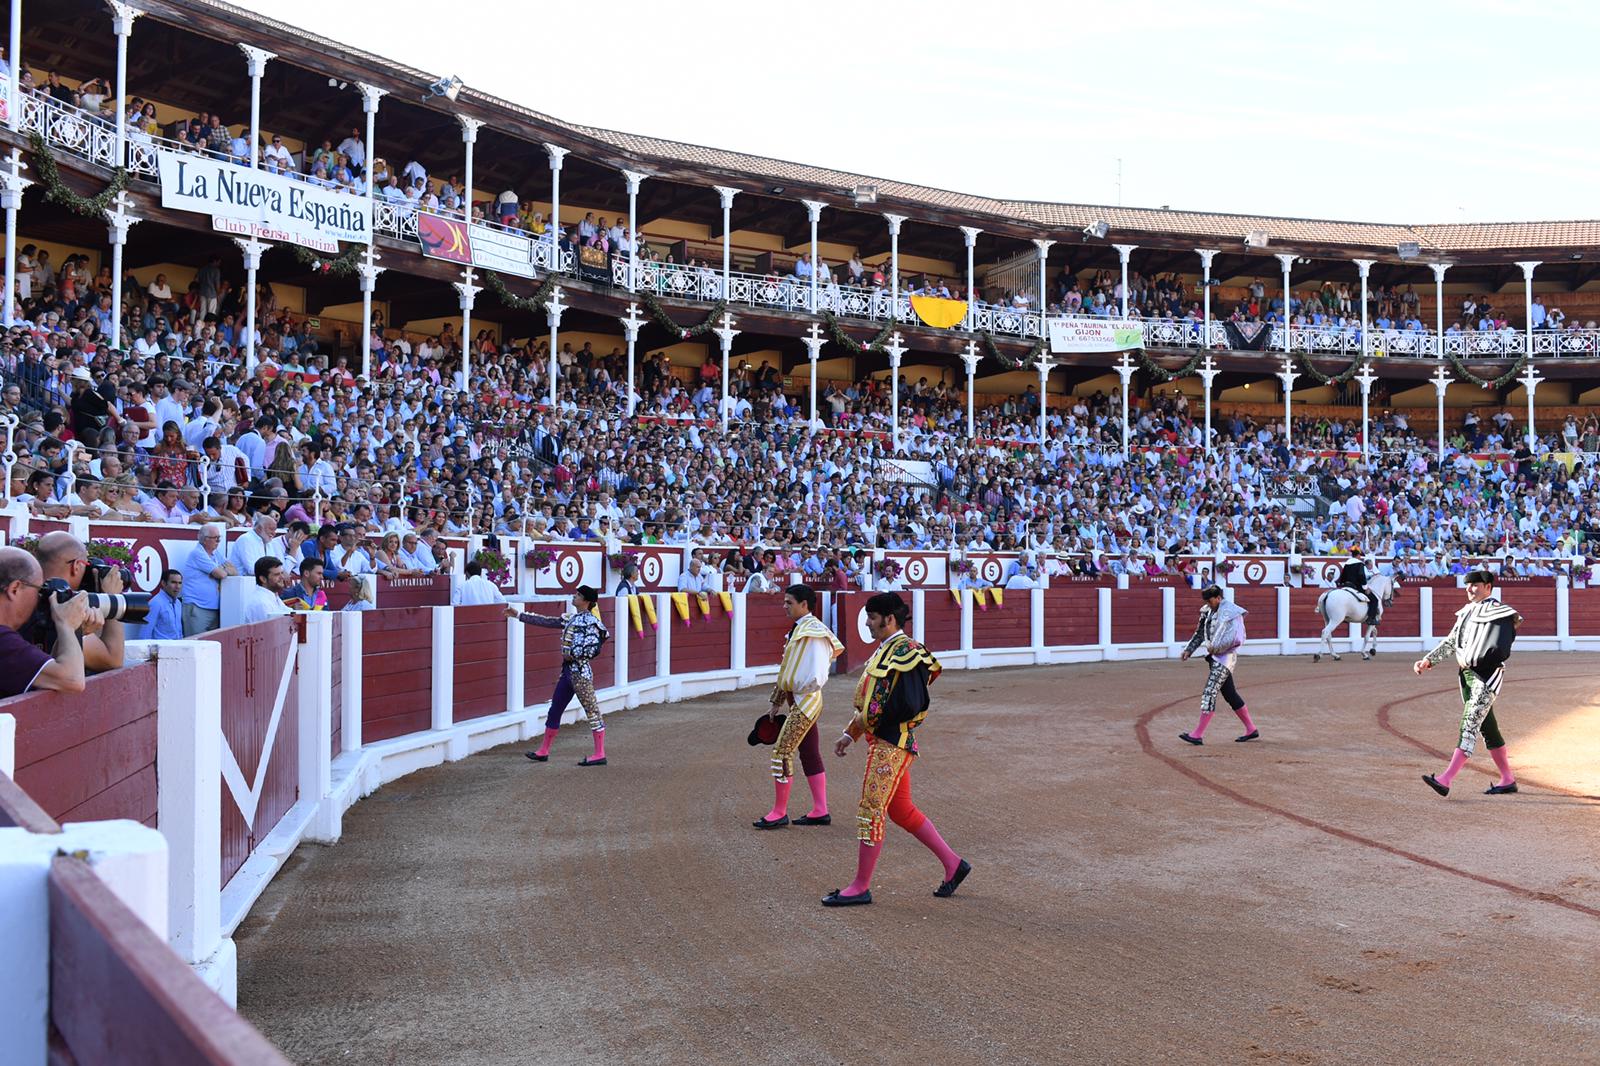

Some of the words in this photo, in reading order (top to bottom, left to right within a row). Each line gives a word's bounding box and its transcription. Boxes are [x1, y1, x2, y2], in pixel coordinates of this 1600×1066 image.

[175, 160, 208, 199] La
[215, 168, 282, 214] Nueva
[287, 186, 366, 232] España
[214, 216, 246, 233] Club
[250, 222, 290, 241] Prensa
[295, 231, 337, 252] Taurina
[1061, 321, 1079, 329] PEÑA
[144, 555, 151, 582] 1
[566, 561, 574, 578] 3
[648, 562, 655, 577] 3
[913, 564, 920, 577] 5
[988, 565, 995, 577] 5
[1252, 567, 1260, 578] 7
[389, 578, 434, 588] AYUNTAMIENTO
